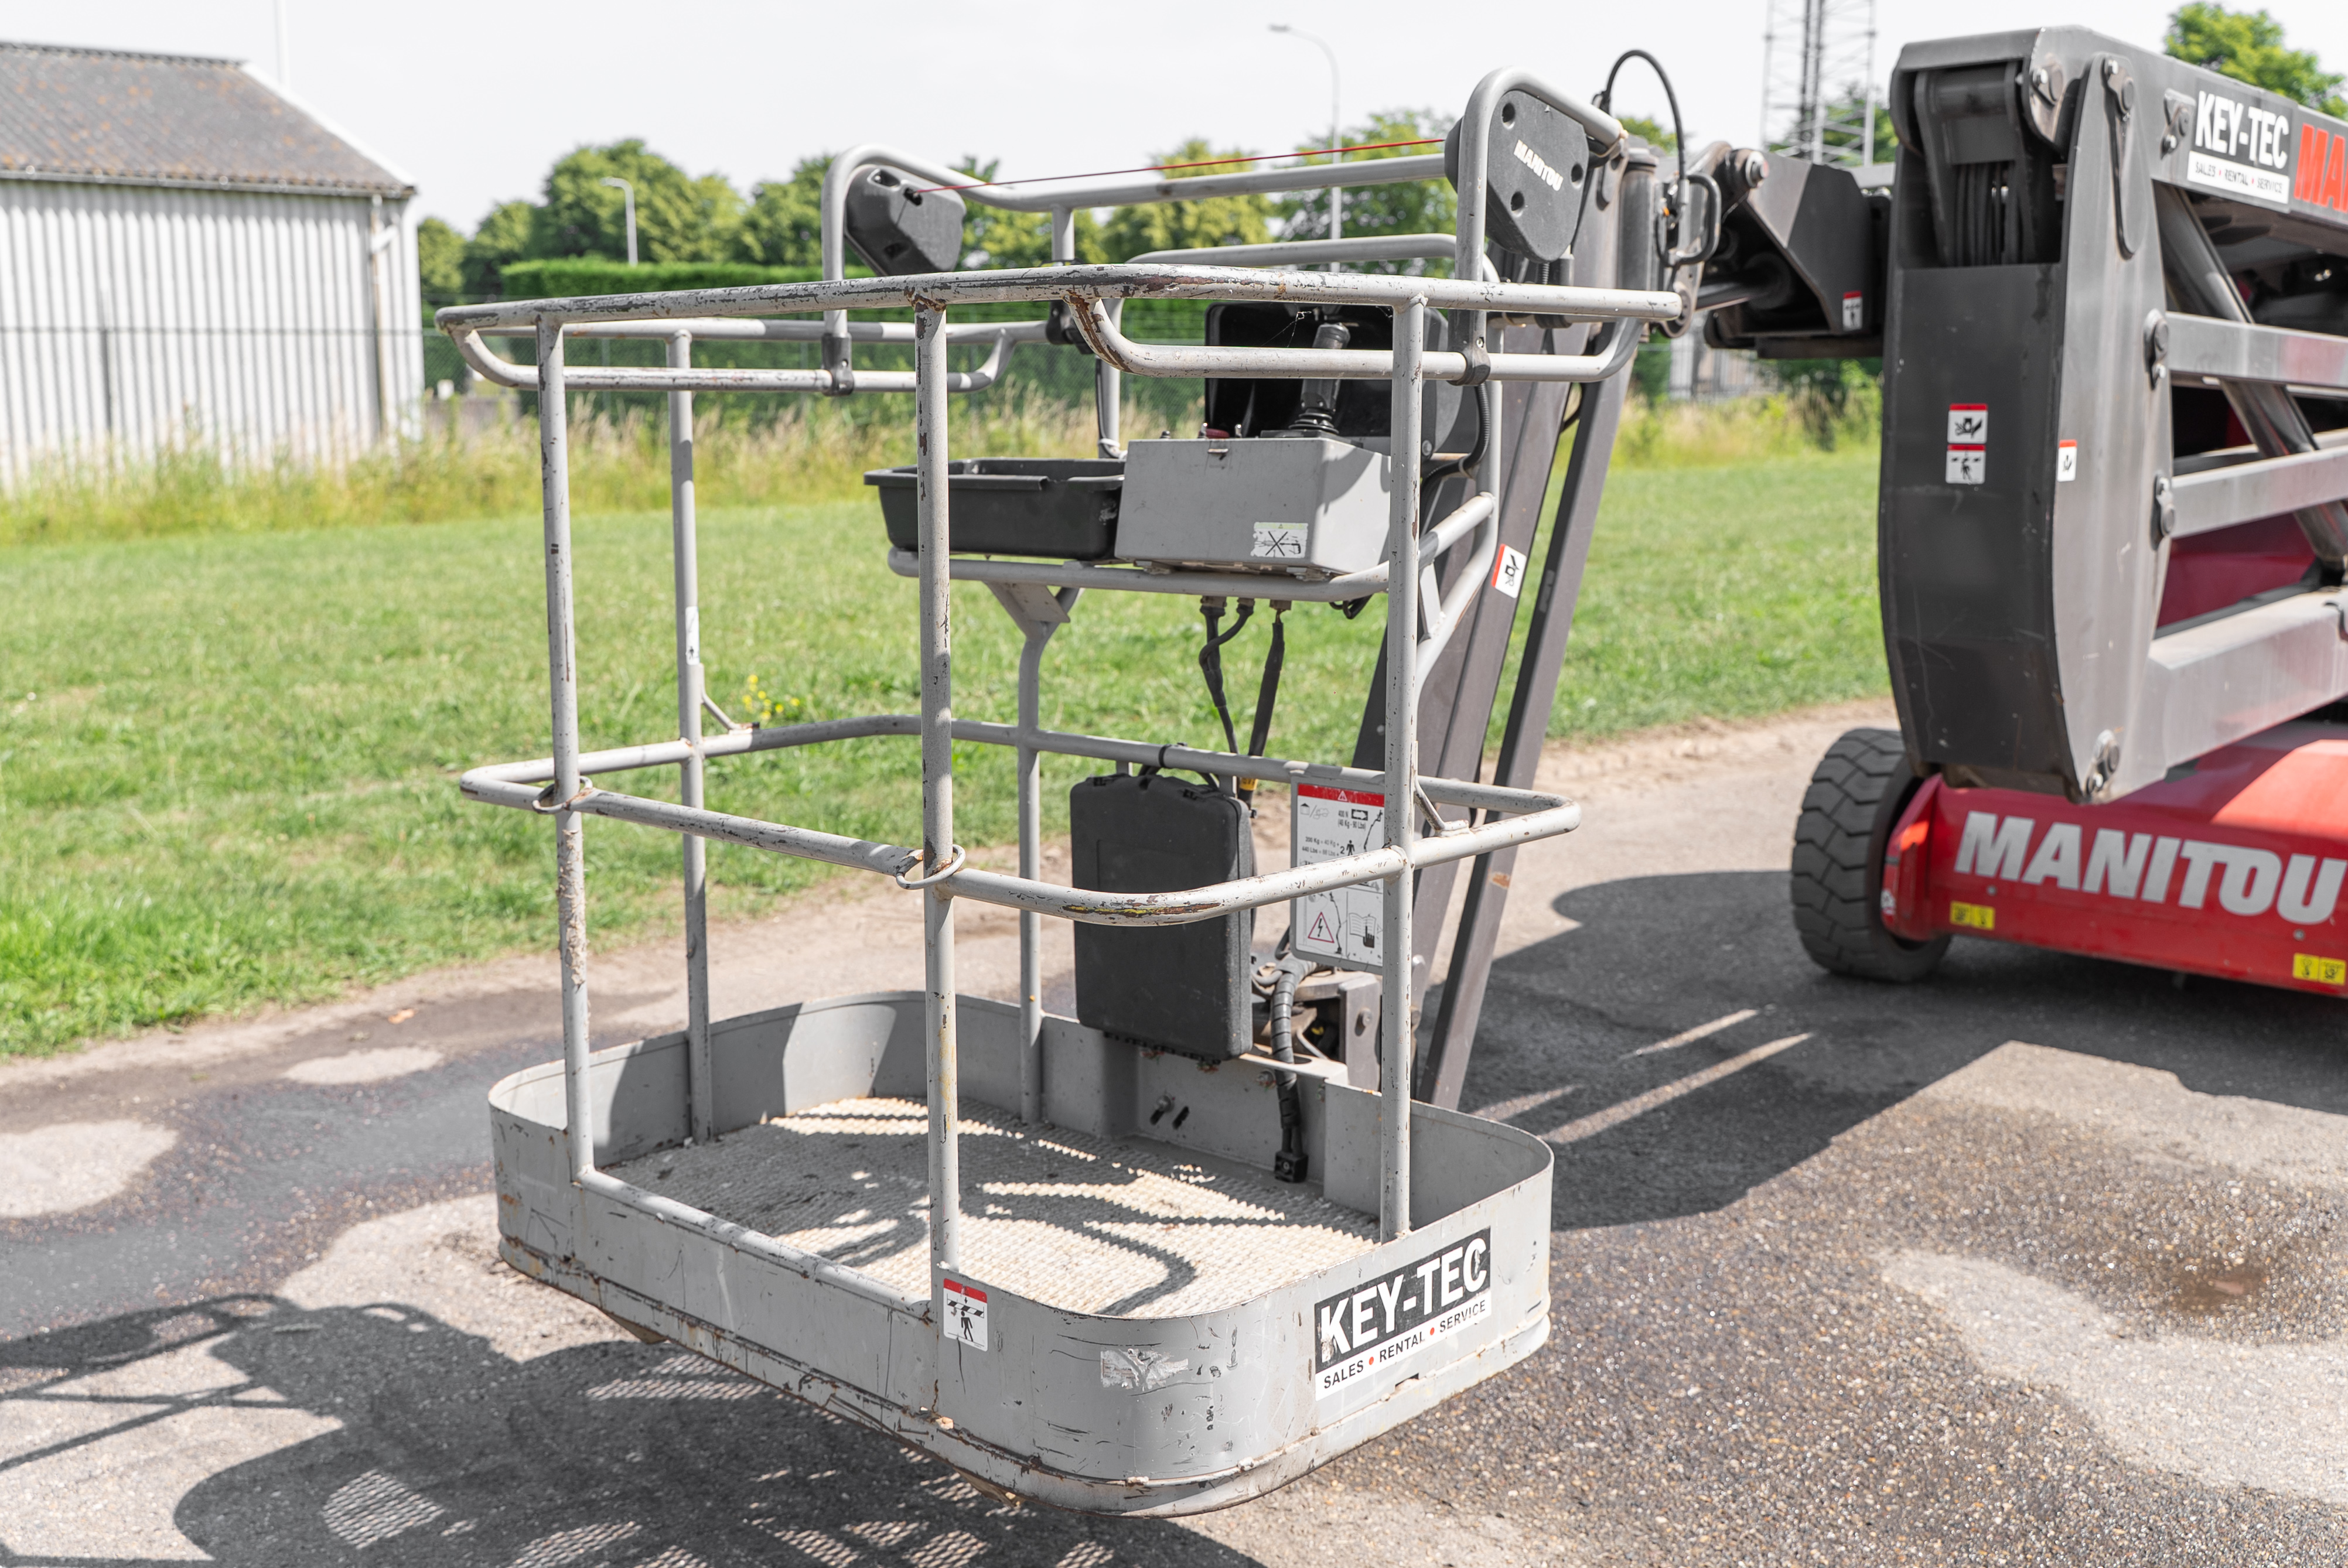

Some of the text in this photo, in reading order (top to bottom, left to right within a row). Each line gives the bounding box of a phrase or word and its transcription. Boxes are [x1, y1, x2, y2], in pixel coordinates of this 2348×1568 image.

[1514, 139, 1564, 191] MANITOU
[2195, 90, 2289, 169] KEY-TEC
[2294, 122, 2348, 214] MA
[2195, 162, 2283, 194] SALES RENTAL SERVICE
[1340, 846, 1345, 854] 2
[1954, 811, 2347, 924] MANITOU
[1320, 1237, 1487, 1363] KEY-TEC
[1324, 1300, 1486, 1389] SALES RENTAL SERVICE
